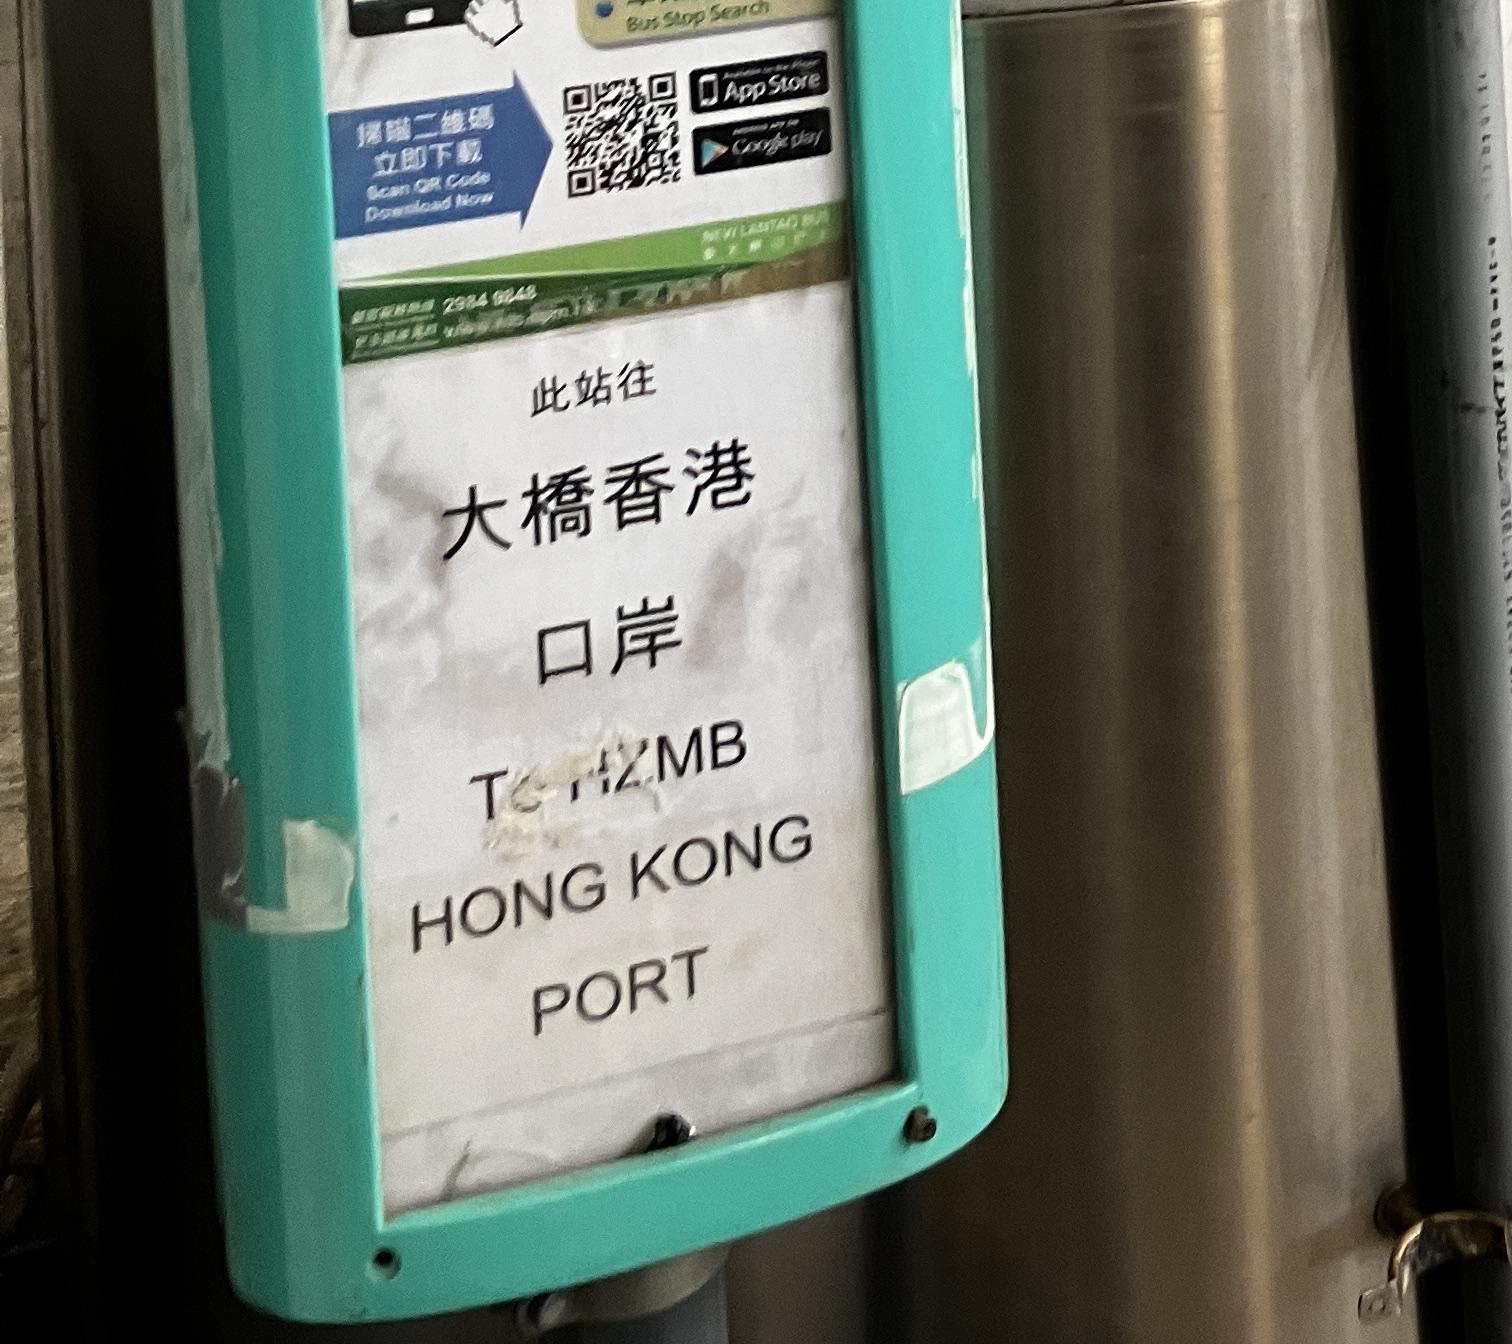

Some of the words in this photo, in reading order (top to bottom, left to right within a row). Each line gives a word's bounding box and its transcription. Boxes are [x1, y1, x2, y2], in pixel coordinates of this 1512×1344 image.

[626, 15, 659, 33] Bus
[662, 9, 705, 29] Stop
[710, 0, 770, 22] Search
[723, 80, 767, 104] App
[768, 73, 821, 96] Store
[530, 359, 657, 418] 此站往
[442, 437, 757, 562] 大橋香港
[536, 595, 682, 686] 口岸
[411, 861, 607, 955] HONG
[630, 813, 813, 900] KONG
[532, 946, 710, 1037] PORT
